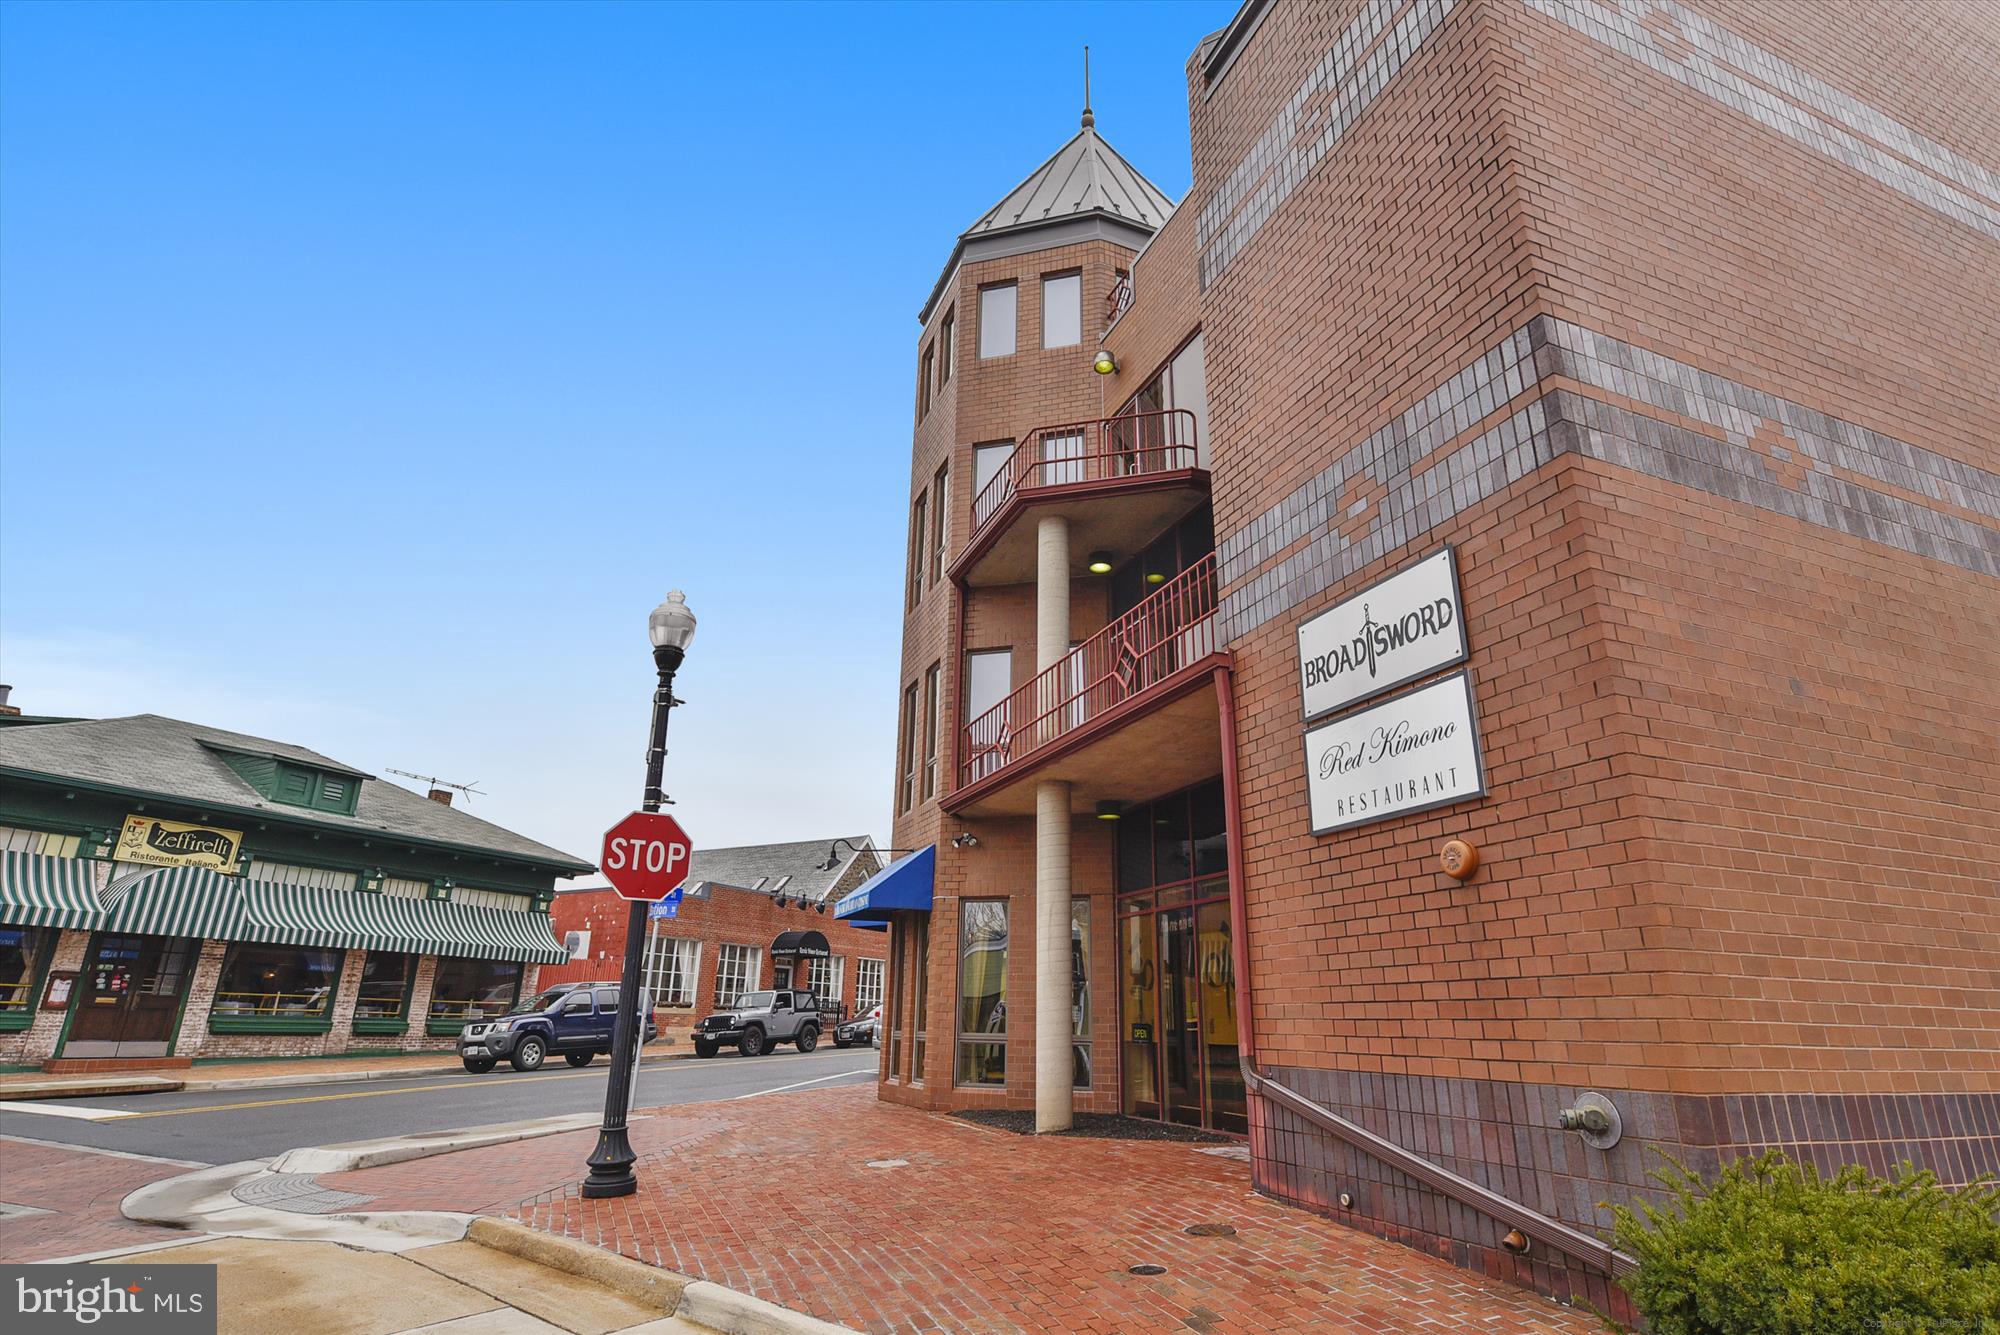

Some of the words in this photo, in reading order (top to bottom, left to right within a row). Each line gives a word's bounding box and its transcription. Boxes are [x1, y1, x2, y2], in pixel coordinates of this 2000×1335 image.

[1319, 741, 1365, 780] Red
[1368, 720, 1457, 764] Kimono
[1337, 767, 1457, 817] RESTAURANT
[154, 830, 229, 855] Zeffirelli
[607, 837, 686, 873] STOP
[129, 850, 180, 865] Ristorante
[185, 857, 219, 870] Italiano
[1134, 1028, 1148, 1039] OPEN
